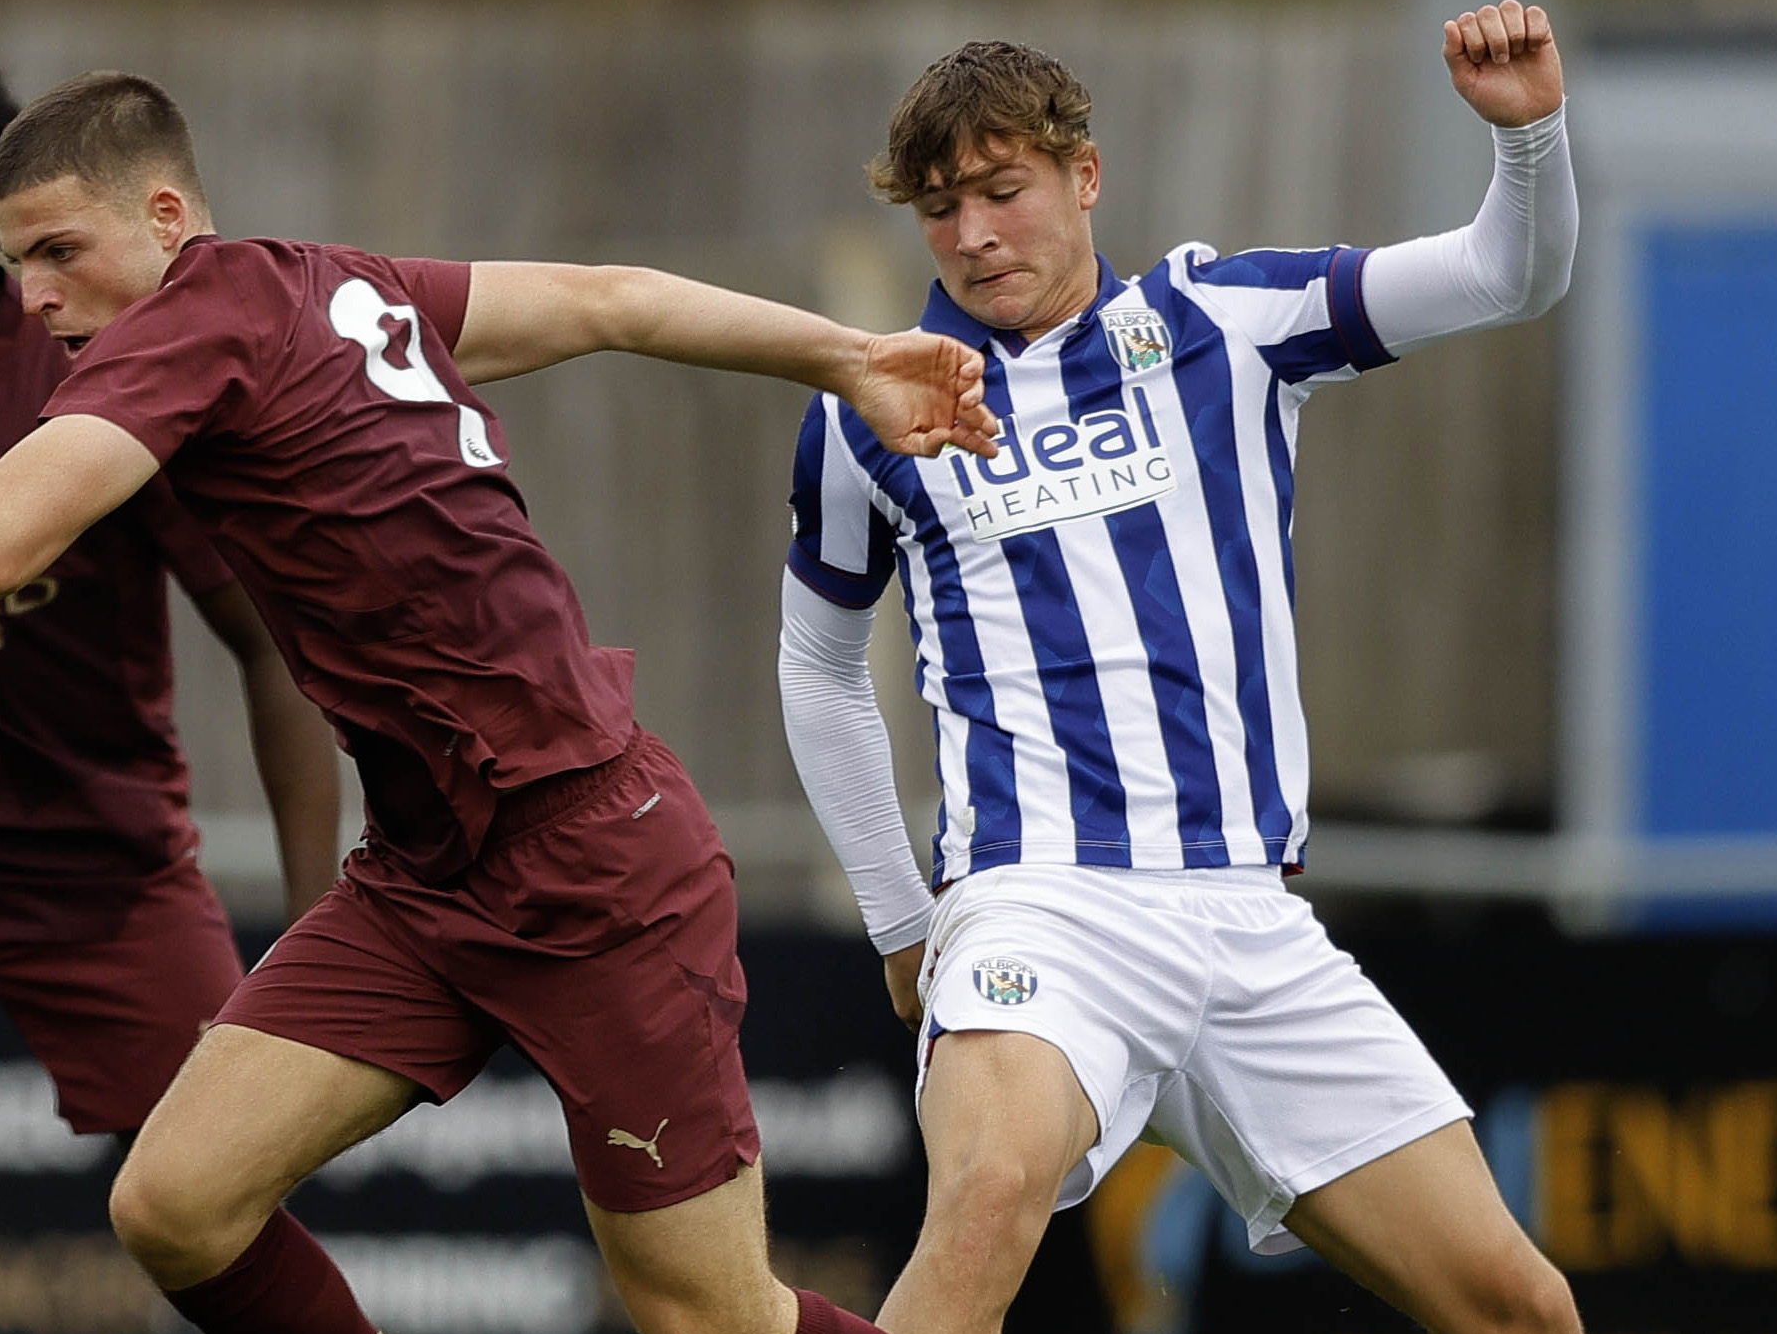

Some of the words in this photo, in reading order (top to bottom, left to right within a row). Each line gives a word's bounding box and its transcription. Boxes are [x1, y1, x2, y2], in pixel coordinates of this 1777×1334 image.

[1107, 314, 1159, 328] ALBION
[945, 385, 1161, 498] ideal
[967, 457, 1171, 531] HEATING
[976, 957, 1033, 977] ALBION
